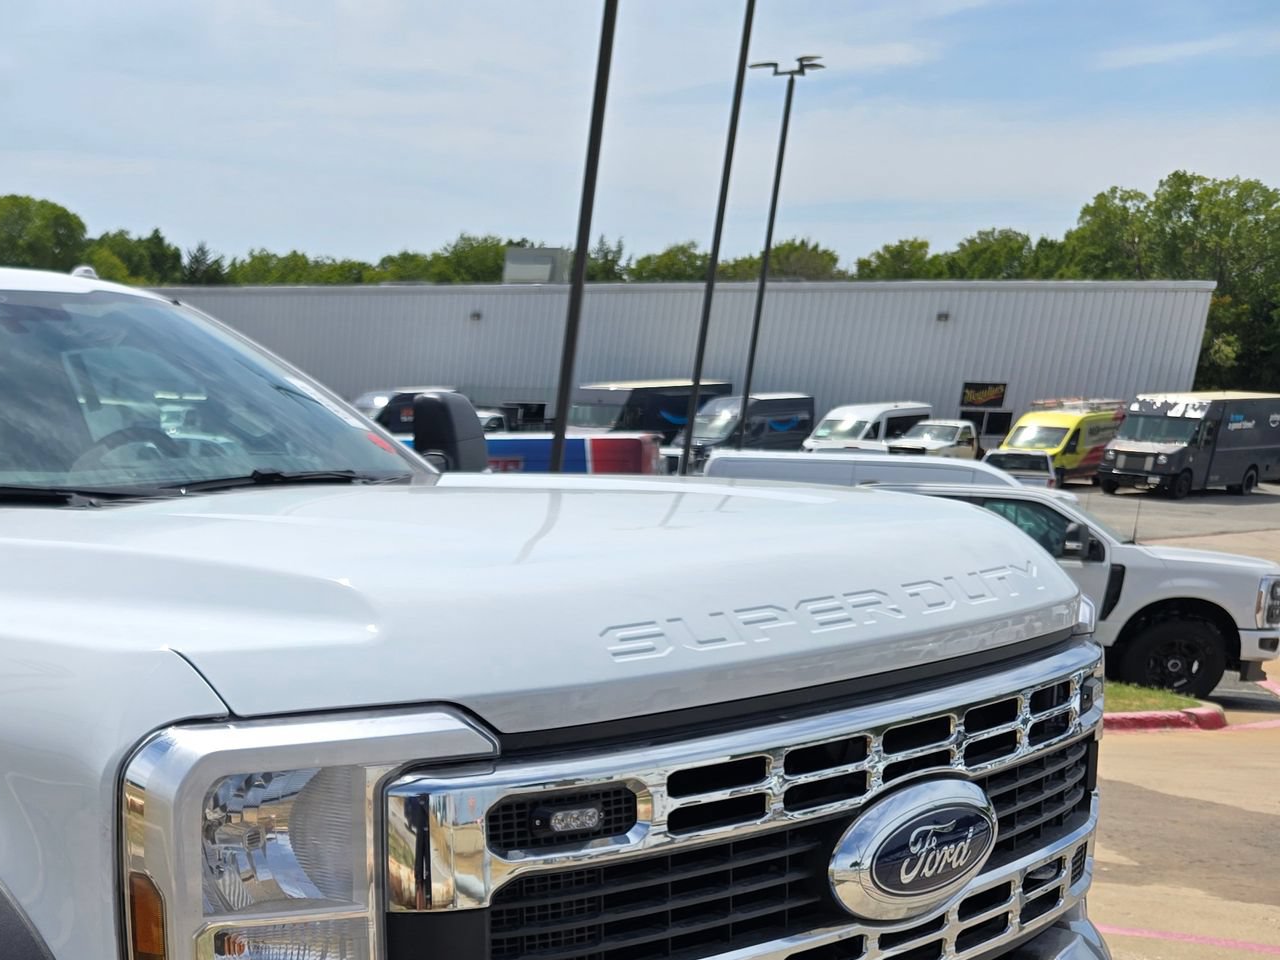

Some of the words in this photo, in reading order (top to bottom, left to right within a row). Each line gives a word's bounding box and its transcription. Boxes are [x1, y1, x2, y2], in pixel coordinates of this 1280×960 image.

[599, 588, 906, 664] SUPER
[901, 560, 1045, 616] DUTY
[900, 819, 972, 884] Ford
